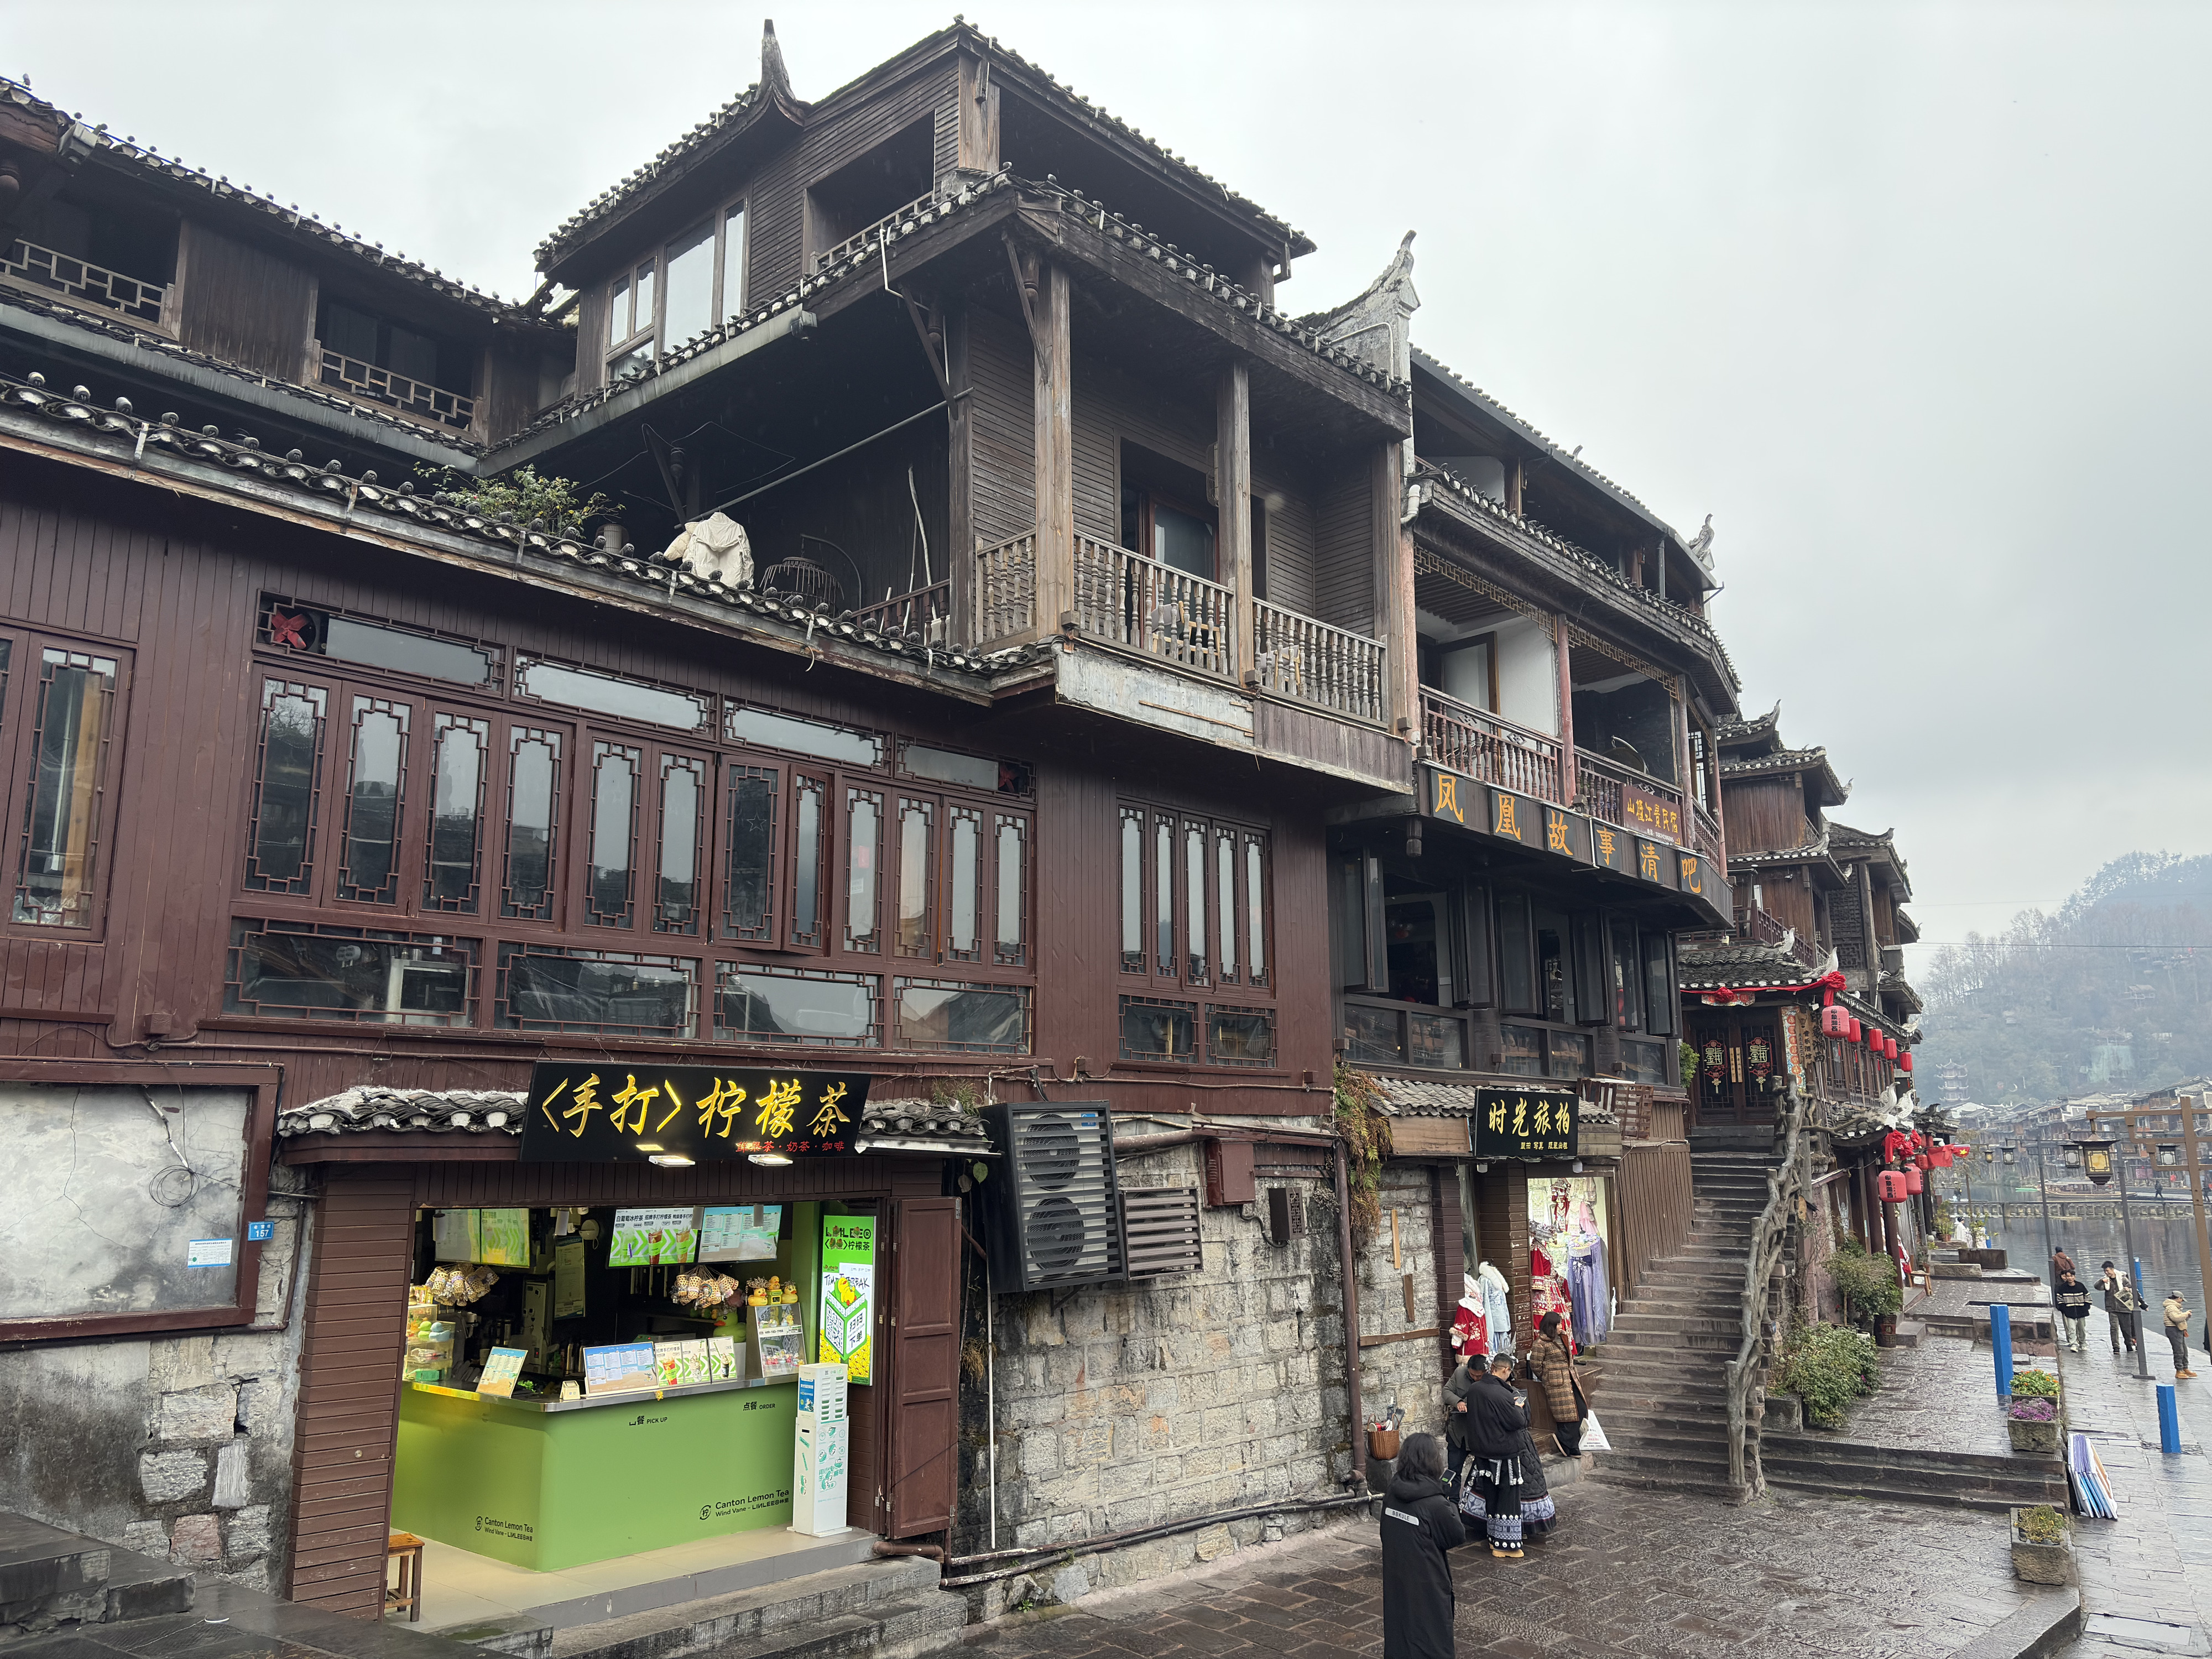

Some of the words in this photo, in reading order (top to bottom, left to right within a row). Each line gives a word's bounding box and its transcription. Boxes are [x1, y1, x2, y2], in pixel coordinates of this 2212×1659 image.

[1435, 773, 1702, 894] 凤凰故事清吧
[1488, 1097, 1571, 1137] 时光旅拍
[1533, 1141, 1544, 1150] 写真
[255, 1229, 269, 1238] 157
[743, 1401, 757, 1411] 点餐
[716, 1499, 745, 1509] Canton
[748, 1493, 774, 1503] Lemon
[1392, 1510, 1410, 1521] BBKULE
[484, 1517, 504, 1527] Canton
[505, 1521, 523, 1531] Lemon
[524, 1524, 533, 1533] Tea
